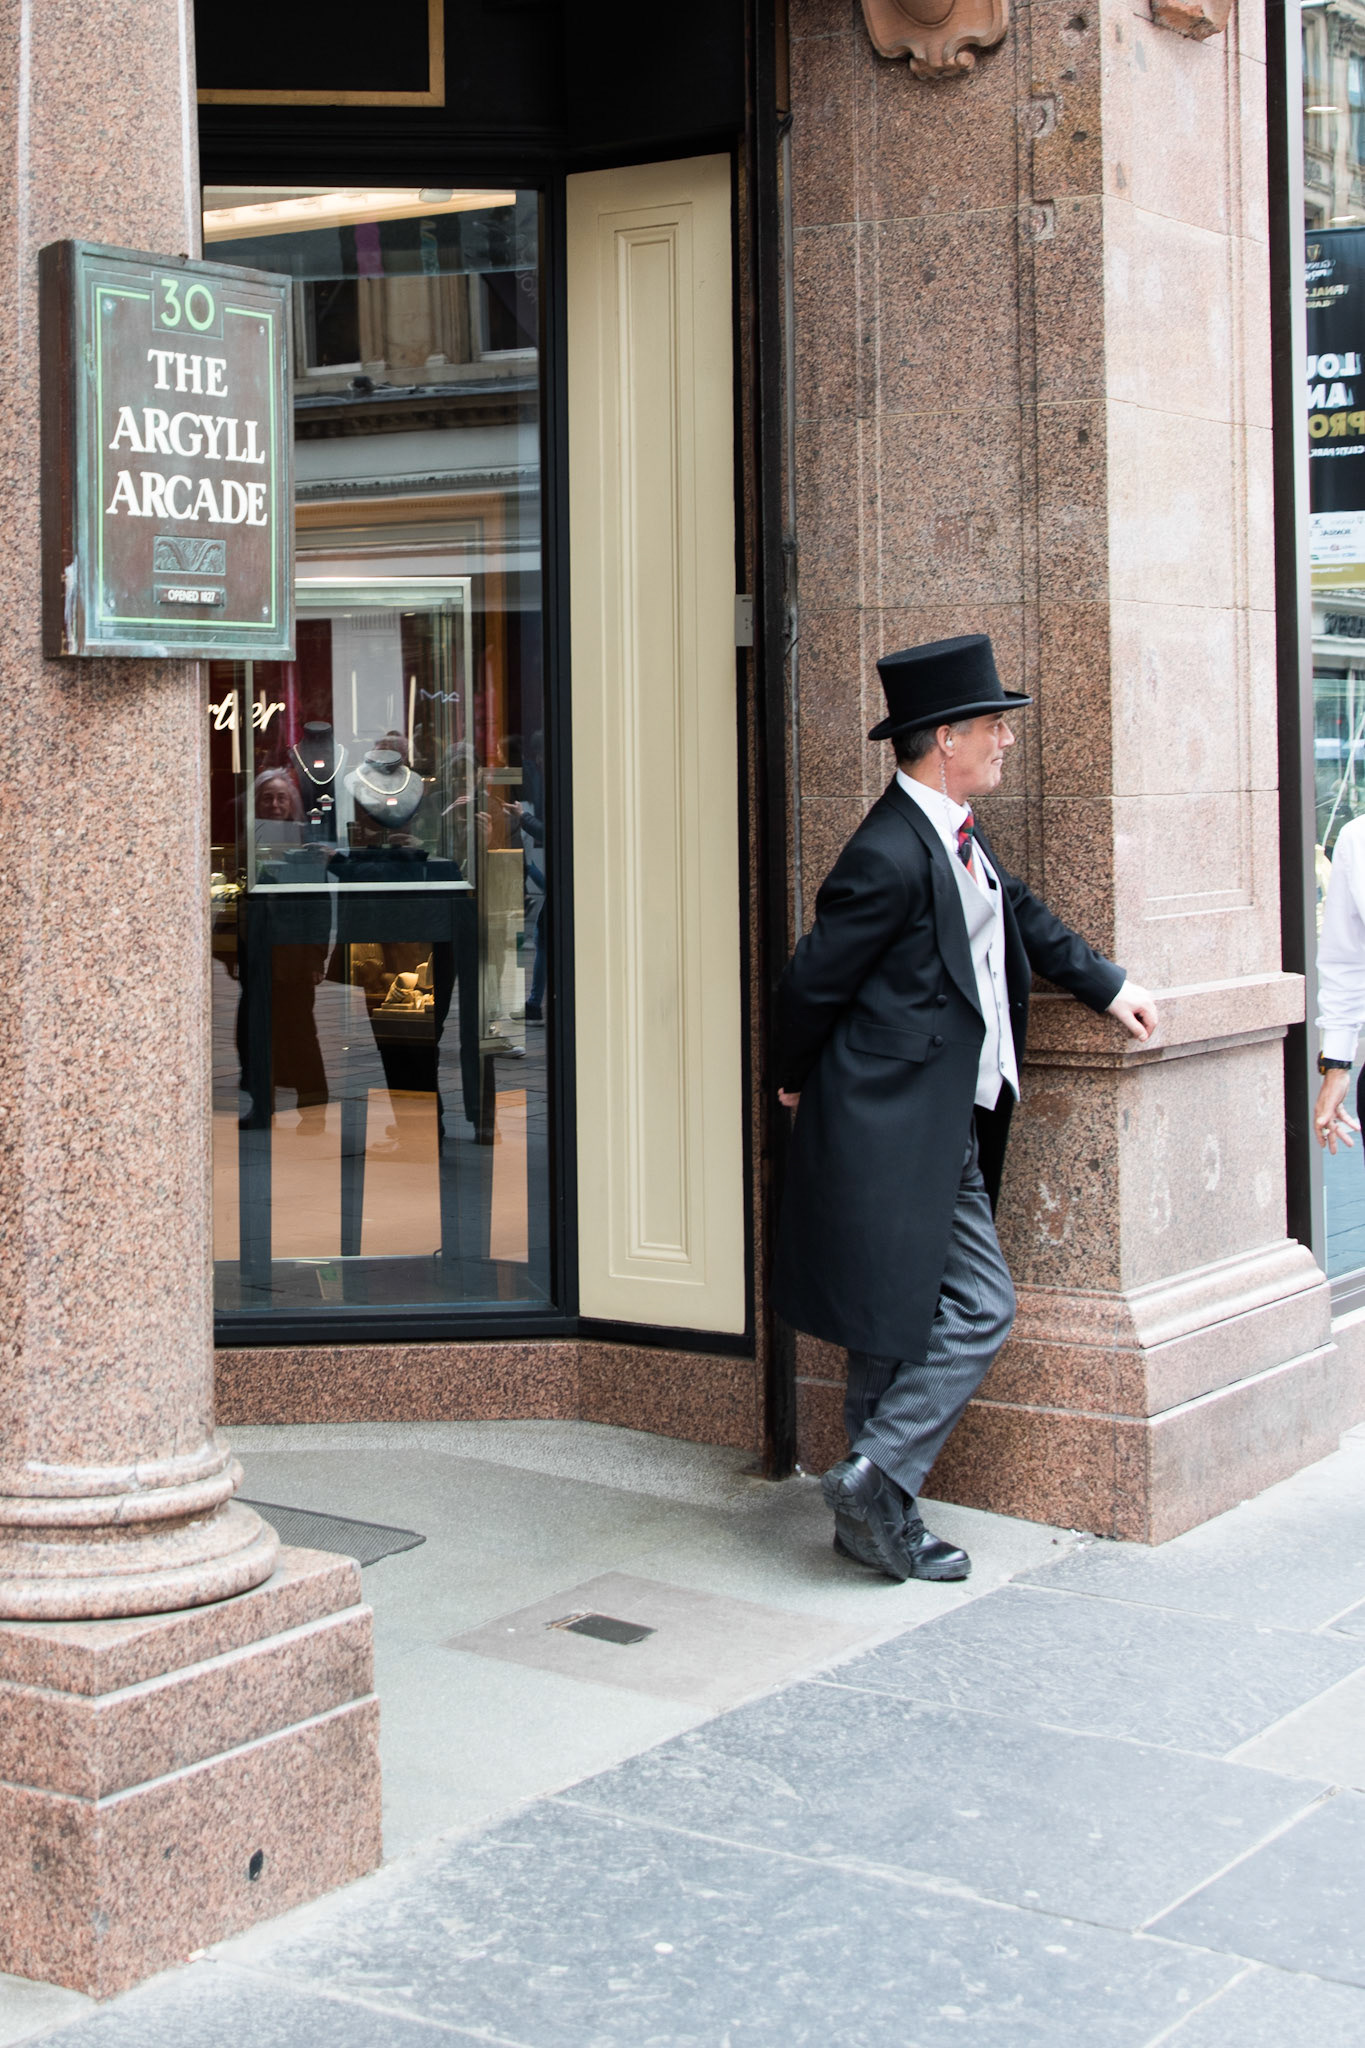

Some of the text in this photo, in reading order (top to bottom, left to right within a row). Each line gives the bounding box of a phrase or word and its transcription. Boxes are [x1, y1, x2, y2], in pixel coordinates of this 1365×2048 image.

[160, 279, 215, 332] 30
[147, 348, 228, 398] THE
[109, 406, 265, 464] ARGYLL
[106, 470, 268, 527] ARCADE
[168, 589, 216, 603] OPENED 1827
